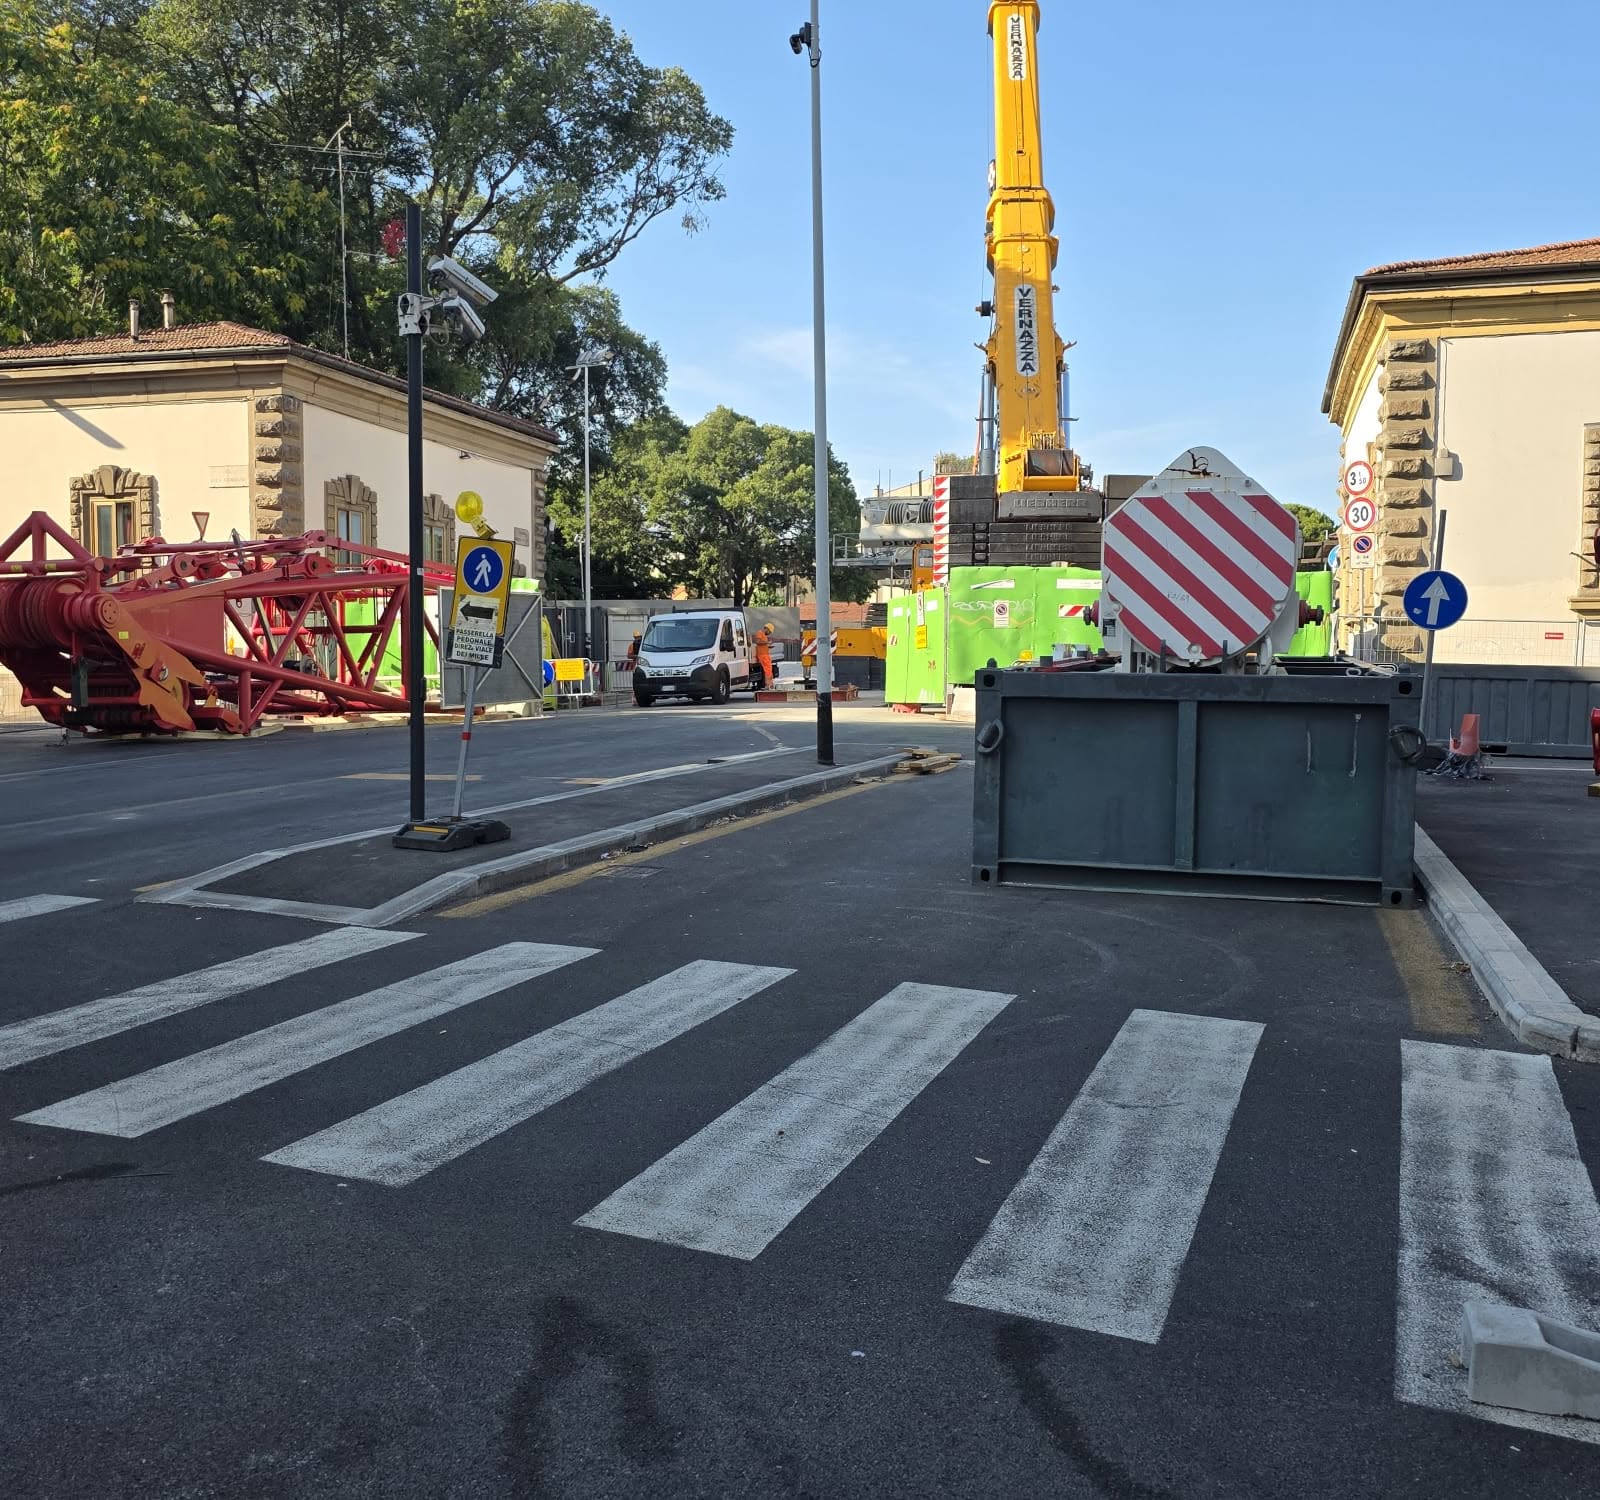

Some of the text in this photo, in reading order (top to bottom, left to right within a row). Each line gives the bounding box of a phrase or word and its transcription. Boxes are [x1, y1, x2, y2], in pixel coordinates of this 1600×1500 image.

[1010, 17, 1023, 78] VERNAZZA
[1018, 288, 1035, 372] VERNAZZA
[1350, 471, 1357, 486] 3
[1352, 505, 1369, 523] 30
[456, 636, 491, 645] PEDONALE
